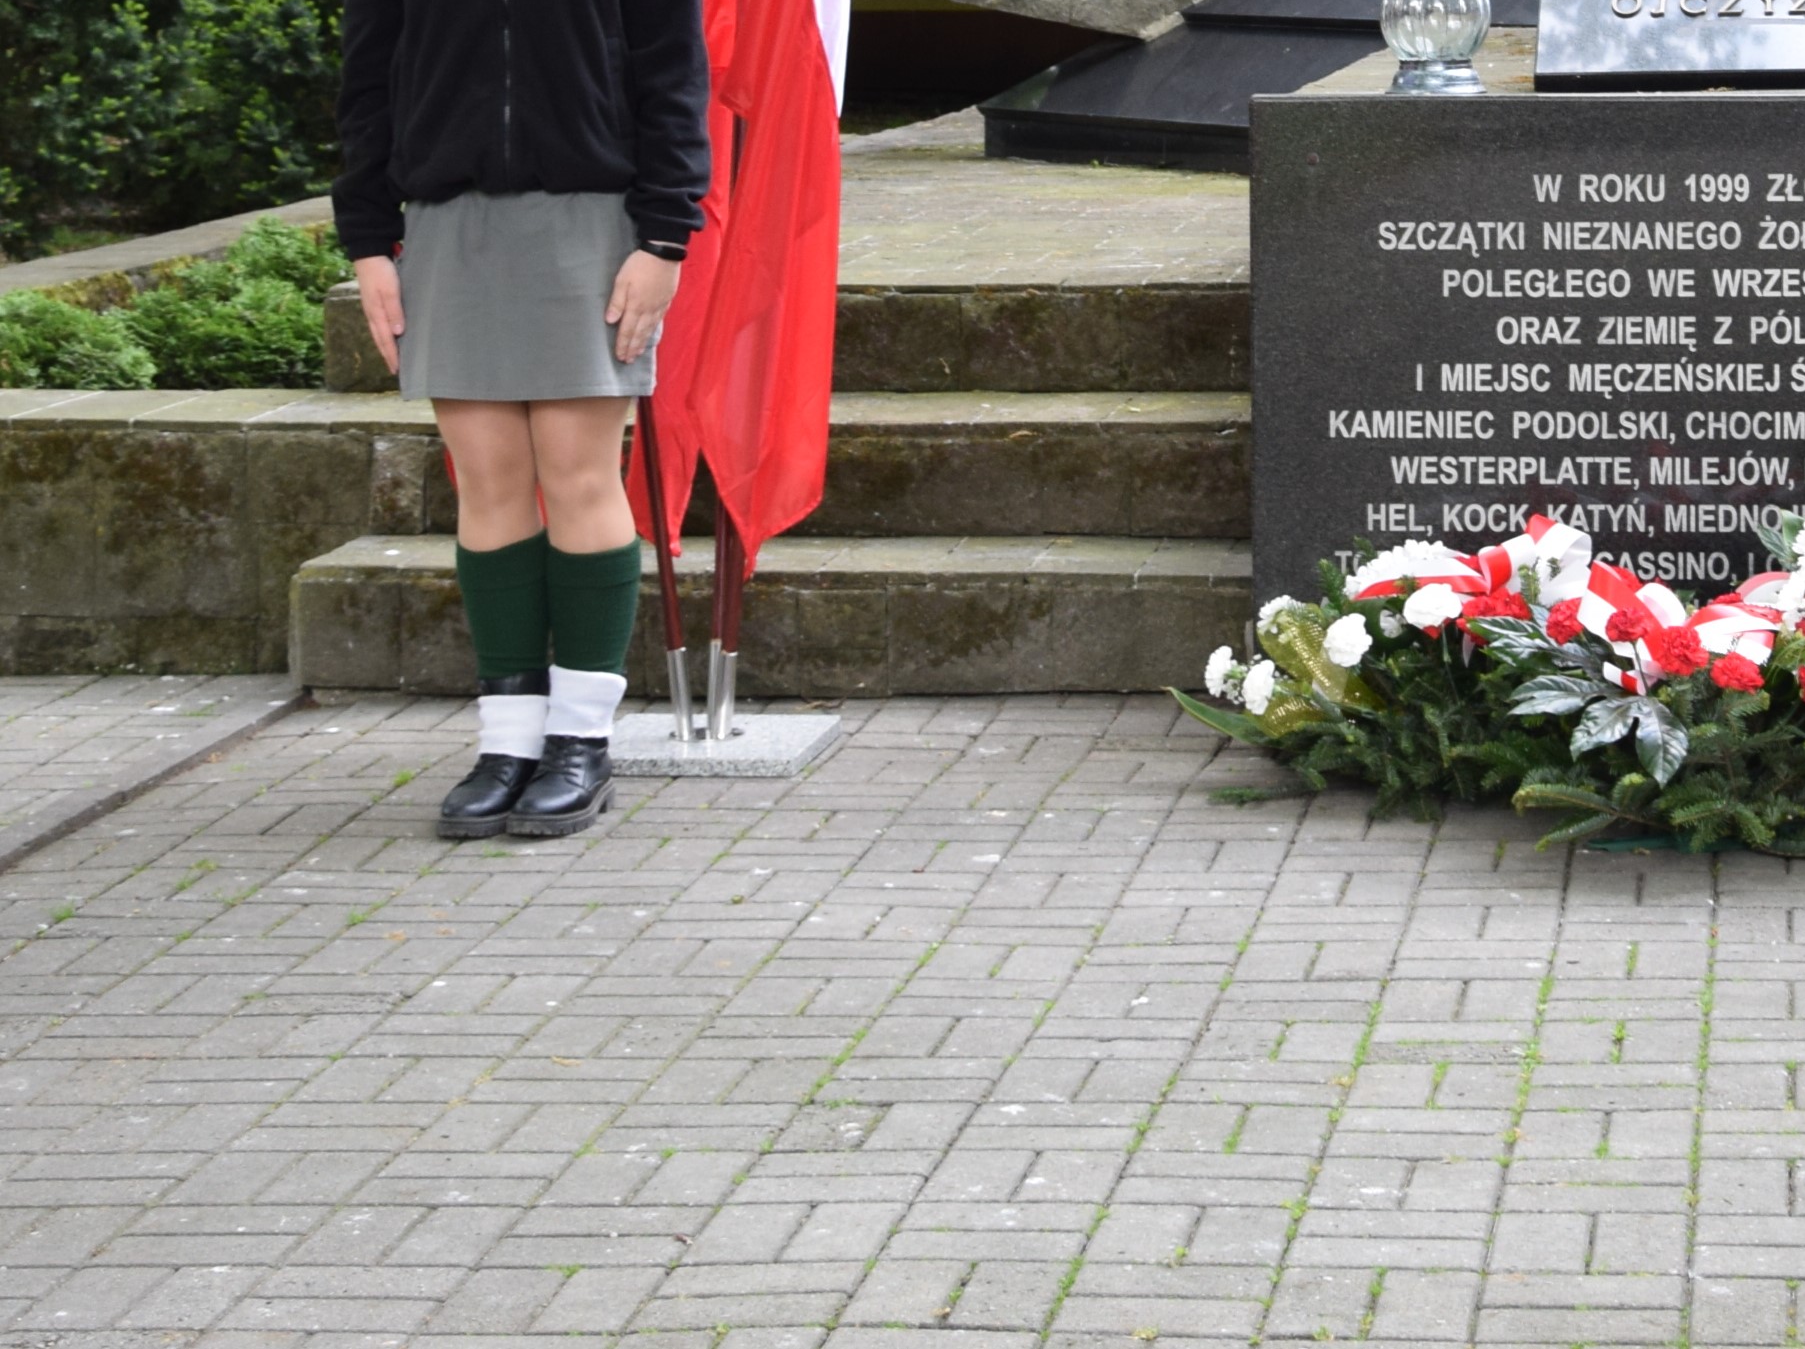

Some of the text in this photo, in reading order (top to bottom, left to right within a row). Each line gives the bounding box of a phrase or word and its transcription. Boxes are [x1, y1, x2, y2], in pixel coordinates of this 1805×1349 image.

[1532, 173, 1563, 203] W
[1578, 173, 1666, 203] ROKU
[1683, 172, 1751, 203] 1999
[1377, 220, 1526, 259] SZCZĄTKI
[1542, 220, 1742, 251] NIEZNANEGO
[1442, 268, 1632, 299] POLEGŁEGO
[1646, 268, 1696, 298] WE
[1495, 315, 1582, 346] ORAZ
[1596, 315, 1697, 353] ZIEMIĘ
[1713, 315, 1734, 345] Z
[1415, 363, 1424, 392] I
[1440, 362, 1551, 393] MIEJSC
[1568, 356, 1781, 400] MĘCZEŃSKIEJ
[1329, 409, 1495, 440] KAMIENIEC
[1512, 410, 1676, 445] PODOLSKI,
[1391, 456, 1641, 490] WESTERPLATTE,
[1649, 450, 1796, 491] MILEJÓW,
[1367, 504, 1433, 536] HEL,
[1547, 497, 1654, 537] KATYŃ,
